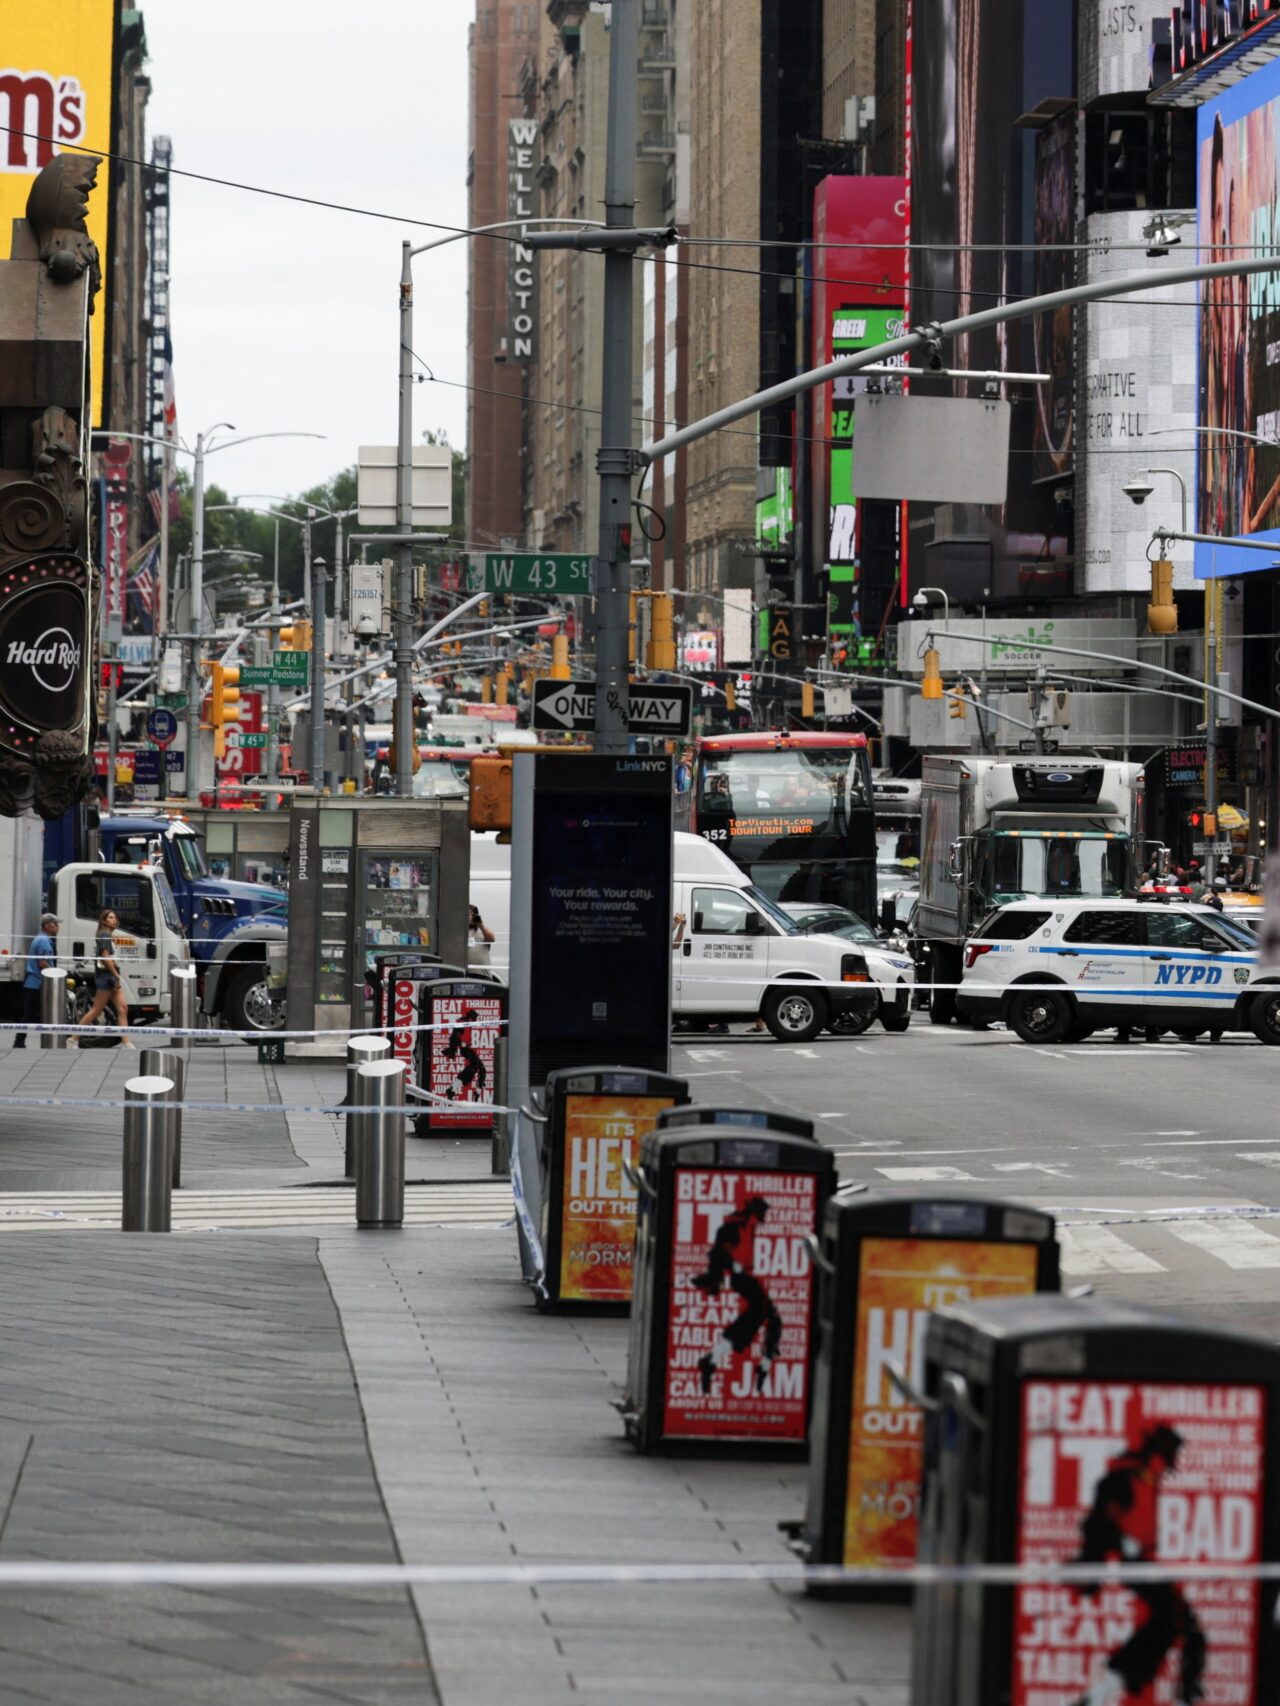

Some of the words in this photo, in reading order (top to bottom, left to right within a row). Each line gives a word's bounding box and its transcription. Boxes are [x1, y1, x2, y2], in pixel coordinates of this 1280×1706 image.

[511, 120, 537, 357] WELLINGTON
[832, 319, 866, 339] GREEN
[1119, 411, 1144, 437] ALL
[492, 559, 515, 588] W
[528, 560, 557, 589] 43
[569, 560, 588, 579] St
[6, 641, 58, 665] Hard
[284, 653, 297, 666] 44
[242, 669, 270, 679] Sumner
[272, 669, 305, 680] Redstone
[554, 696, 596, 716] ONE
[628, 699, 676, 720] WAY
[616, 760, 667, 772] LinkNYC
[702, 828, 728, 841] 352
[786, 825, 813, 834] TOUR
[298, 819, 311, 881] Newsstand
[548, 887, 575, 898] Your
[602, 888, 627, 898] Your
[564, 900, 589, 911] Your
[590, 901, 640, 911] rewards.
[713, 943, 745, 951] CONTRACTING
[1154, 964, 1223, 985] NYPD
[433, 1000, 463, 1013] BEAT
[464, 1000, 500, 1009] THRILLER
[471, 1029, 498, 1048] BAD
[432, 1064, 465, 1073] JEAN
[433, 1057, 465, 1065] BILLIE
[605, 1122, 635, 1137] IT'S
[570, 1136, 639, 1199] HEL
[677, 1173, 740, 1202] BEAT
[744, 1175, 816, 1194] THRILLER
[569, 1200, 606, 1214] OUT
[675, 1202, 737, 1244] IT
[570, 1250, 631, 1266] MORM
[752, 1237, 809, 1277] BAD
[672, 1291, 741, 1308] BILLIE
[768, 1289, 808, 1300] BACK
[672, 1307, 739, 1325] JEAN
[730, 1361, 804, 1399] JAM
[1026, 1383, 1133, 1433] BEAT
[1139, 1386, 1263, 1418] THRILLER
[862, 1411, 922, 1433] OUT
[1025, 1436, 1128, 1506] IT
[1155, 1494, 1255, 1561] BAD
[1020, 1588, 1137, 1616] BILLIE
[1019, 1618, 1136, 1646] JEAN
